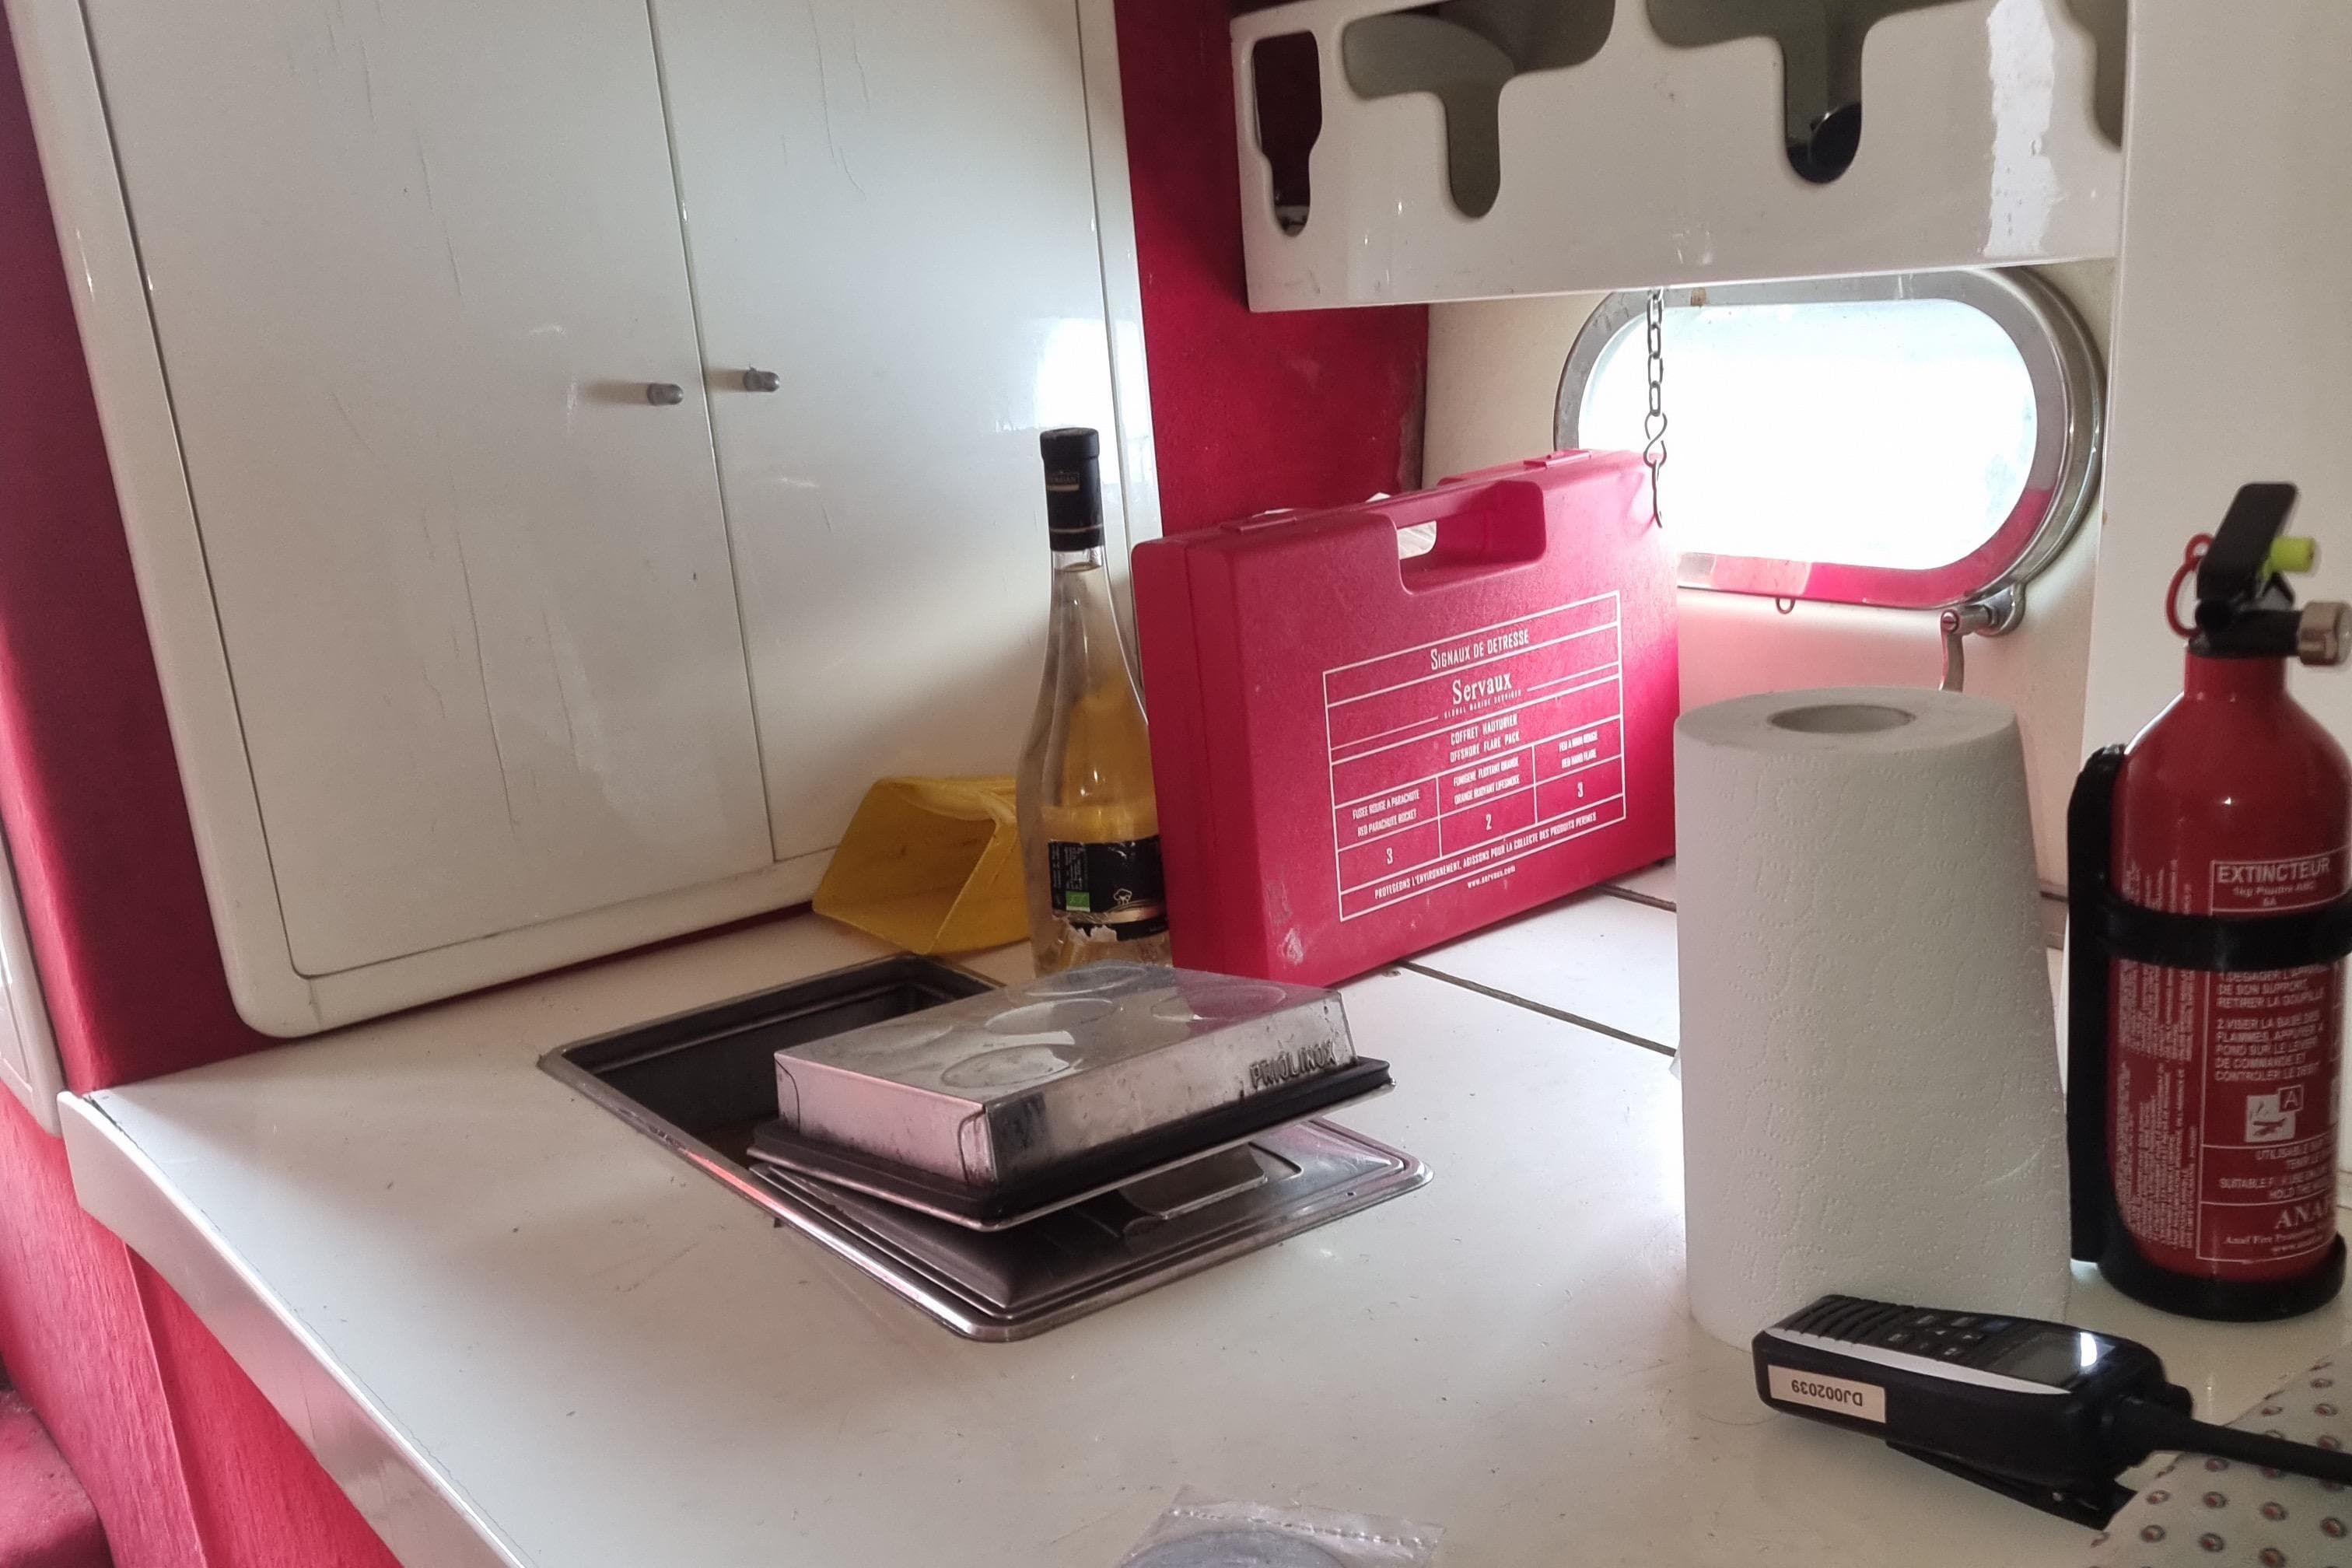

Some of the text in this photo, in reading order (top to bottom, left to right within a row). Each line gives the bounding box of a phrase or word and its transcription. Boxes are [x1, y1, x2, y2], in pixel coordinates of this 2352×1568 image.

[1430, 628, 1529, 670] SIGNAUX DE DETRESSE
[1452, 673, 1512, 705] Servaux
[1451, 713, 1518, 746] COFFRET HAUTURIER
[1450, 731, 1520, 763] OFFSHORE FLARE PACK
[1577, 781, 1584, 798] 3
[1486, 813, 1492, 831] 2
[1374, 877, 1410, 899] PROTEGEONS
[1463, 850, 1490, 869] AGISSONS
[1490, 843, 1507, 859] POUR
[1507, 841, 1514, 853] LA
[1514, 832, 1538, 850] COLLECTE
[1539, 828, 1550, 841] DES
[1386, 847, 1393, 865] 3
[2218, 857, 2330, 884] EXTINCTEUR
[2284, 1090, 2298, 1109] A
[1791, 1379, 1863, 1407] DJ002039
